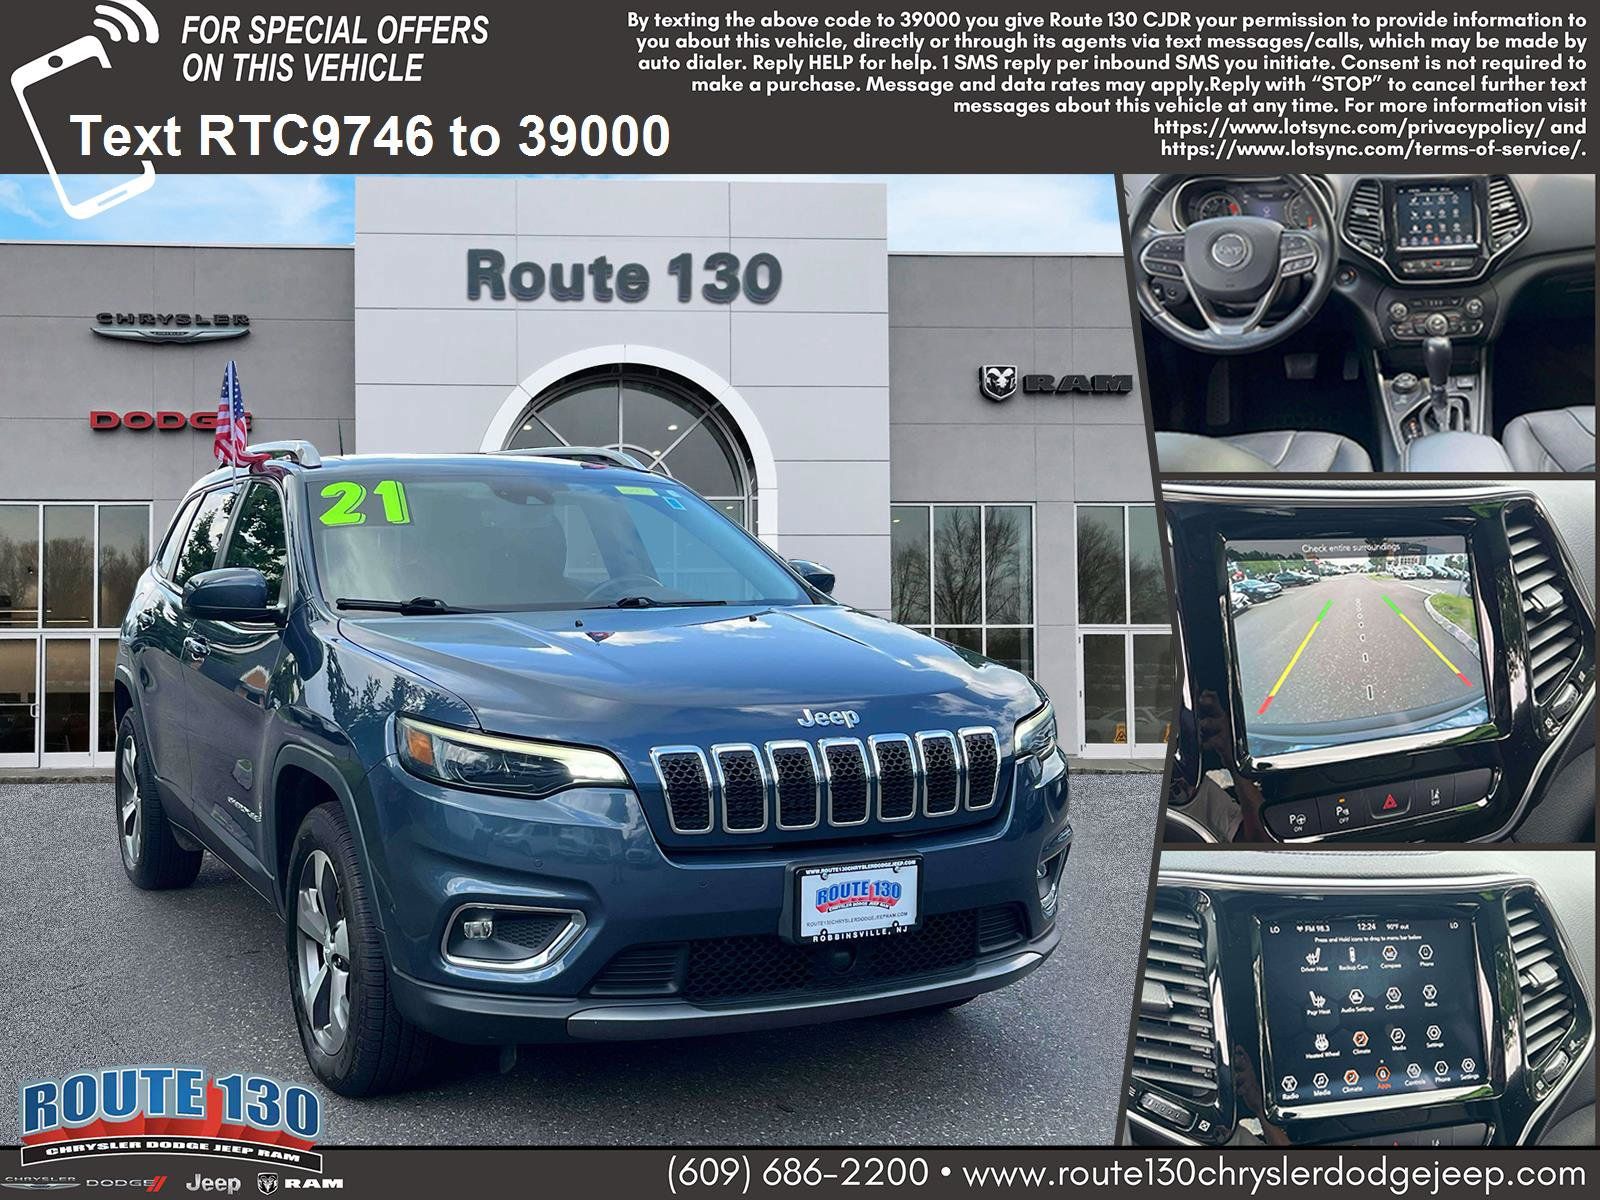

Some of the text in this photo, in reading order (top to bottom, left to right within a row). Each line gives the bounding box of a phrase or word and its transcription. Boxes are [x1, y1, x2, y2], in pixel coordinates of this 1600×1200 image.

[467, 249, 782, 304] Route 130
[96, 313, 250, 326] CHRYSLER
[1023, 375, 1133, 394] RAM
[89, 411, 253, 430] DODG
[320, 480, 410, 526] 21
[1301, 543, 1327, 553] Check
[1329, 543, 1350, 552] entire
[1352, 542, 1401, 553] surroundings
[797, 708, 860, 729] Jeep
[816, 880, 902, 906] ROUTE 130
[813, 927, 891, 942] ROBBINSVILLE,
[1269, 926, 1281, 934] LO
[1357, 923, 1377, 931] 12:24
